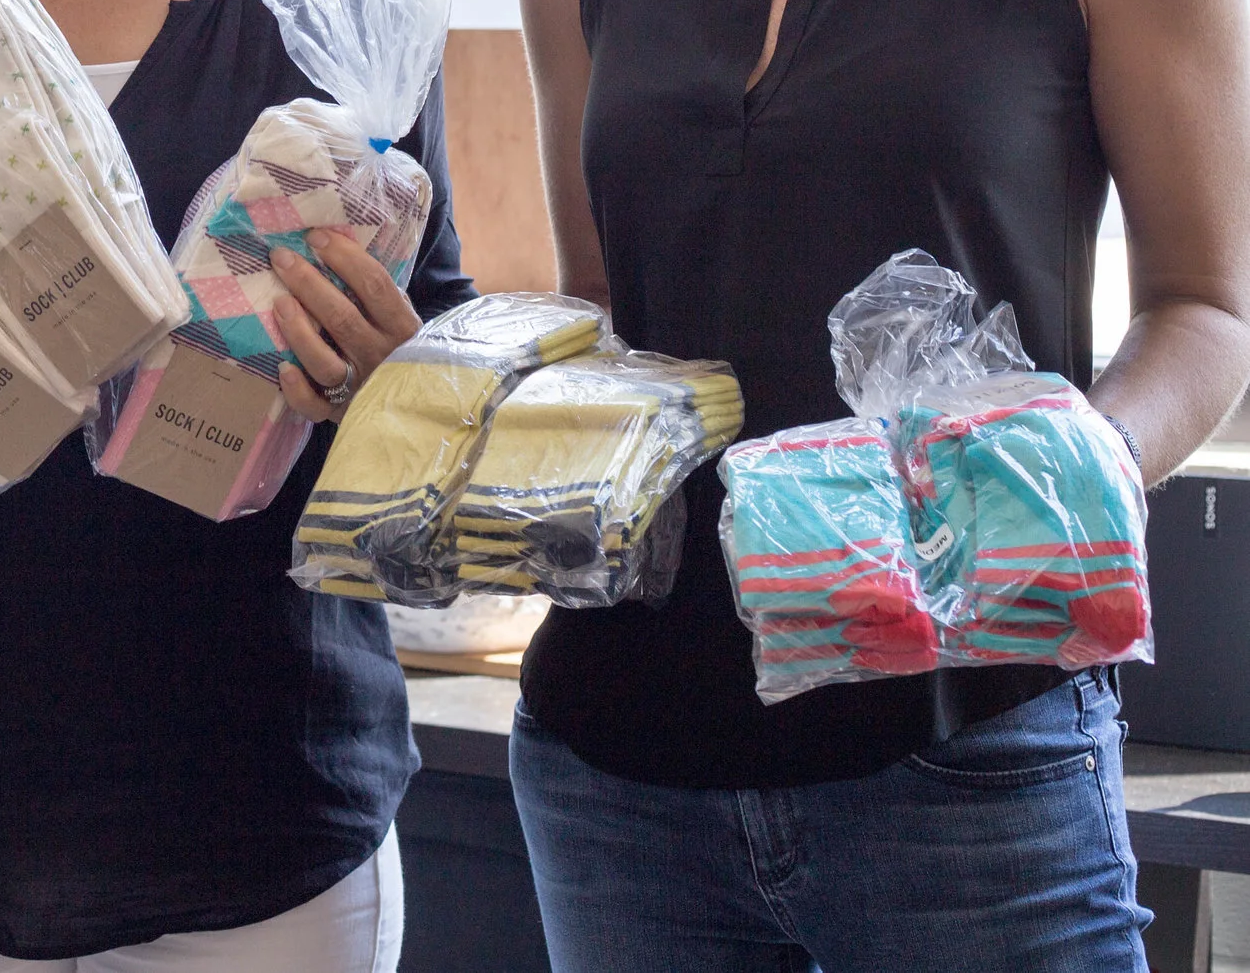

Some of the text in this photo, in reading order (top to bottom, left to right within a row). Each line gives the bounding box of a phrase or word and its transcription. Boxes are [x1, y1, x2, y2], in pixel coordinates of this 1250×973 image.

[23, 288, 58, 322] SOCK
[62, 256, 95, 289] CLUB
[155, 403, 195, 432] SOCK
[205, 425, 244, 453] CLUB
[1205, 486, 1217, 529] SONOS
